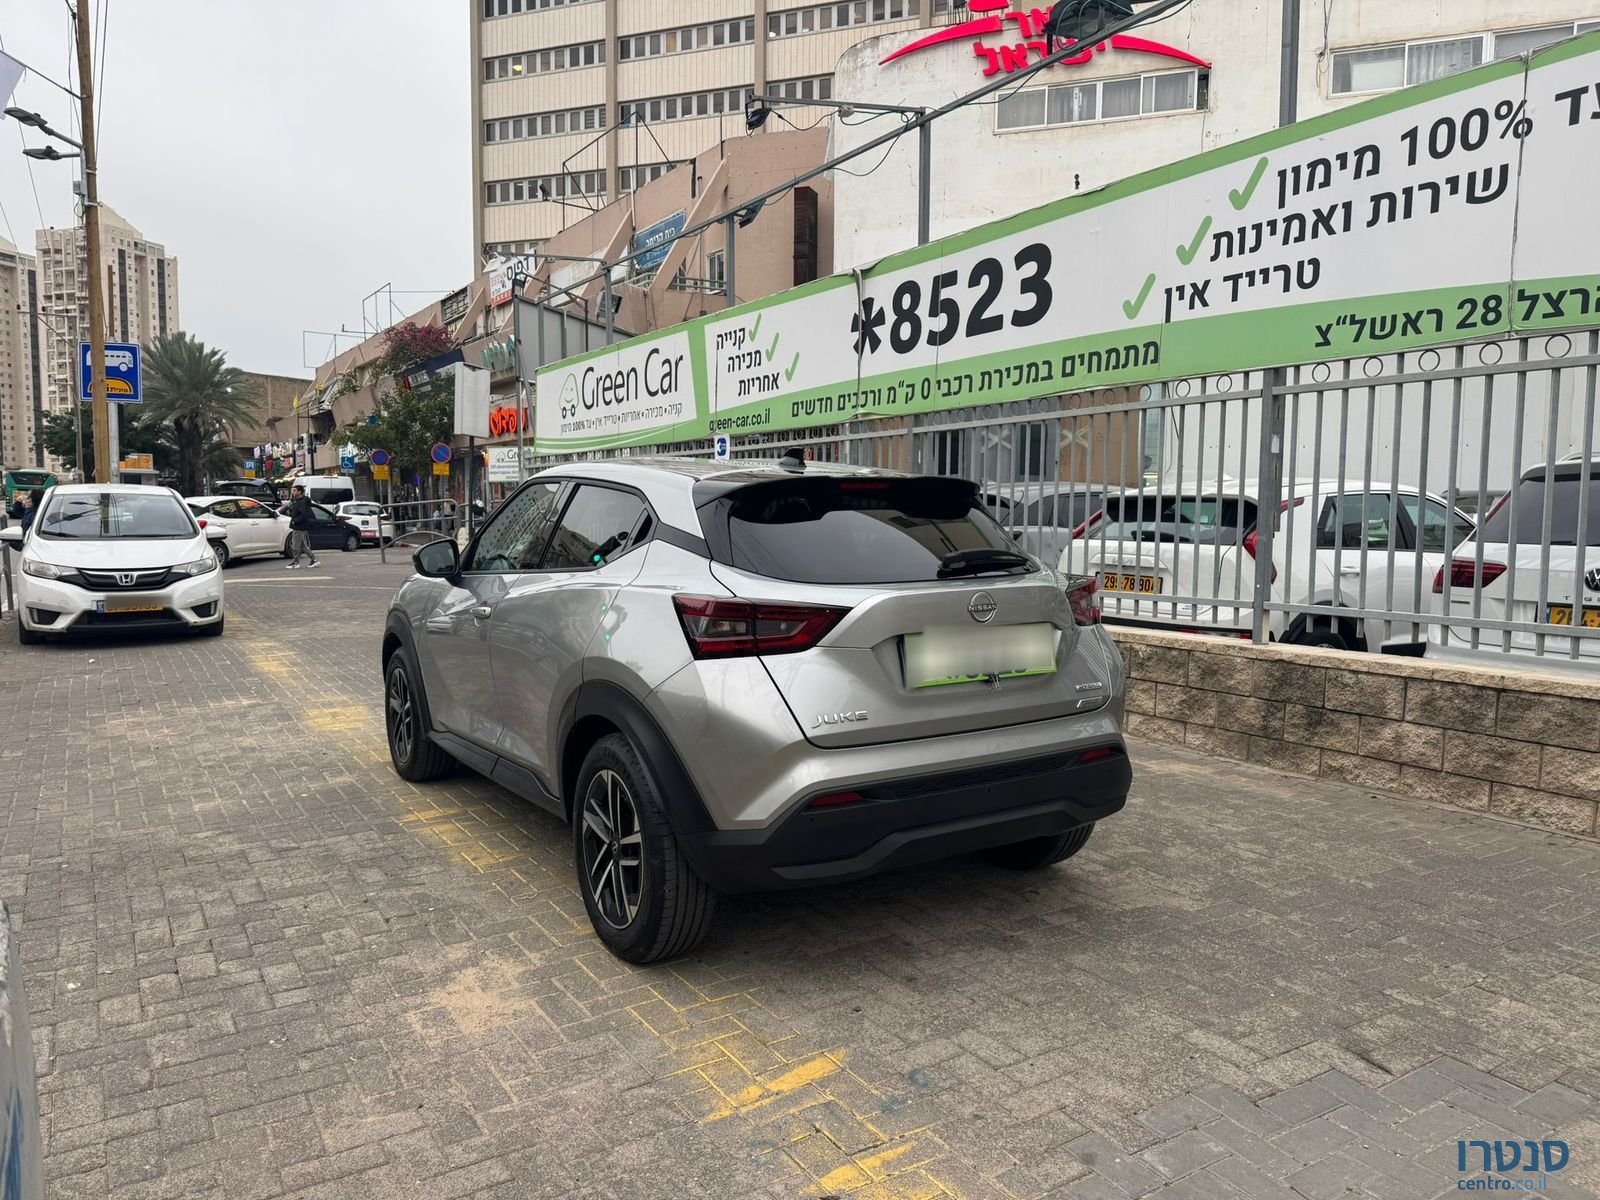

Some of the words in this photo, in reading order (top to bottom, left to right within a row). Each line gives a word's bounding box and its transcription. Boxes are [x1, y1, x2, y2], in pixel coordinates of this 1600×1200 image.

[1400, 99, 1534, 167] 100%
[1277, 143, 1381, 209] מימון
[1367, 163, 1509, 228] שירות
[1209, 200, 1351, 262] ואמינות
[1223, 256, 1321, 302] טרייד
[1164, 279, 1211, 323] אין
[1456, 294, 1503, 330] 28
[716, 327, 746, 350] קנייה
[728, 349, 762, 373] מכירה
[978, 360, 1053, 391] במכירת
[1061, 340, 1160, 378] מתמחים
[581, 366, 638, 410] Green
[644, 347, 684, 398] Car
[738, 372, 780, 397] אחריות
[936, 374, 973, 397] רכבי
[792, 396, 833, 417] חדשים
[837, 388, 882, 411] ורכבים
[968, 604, 997, 612] NISSAN
[811, 710, 869, 729] JUKE
